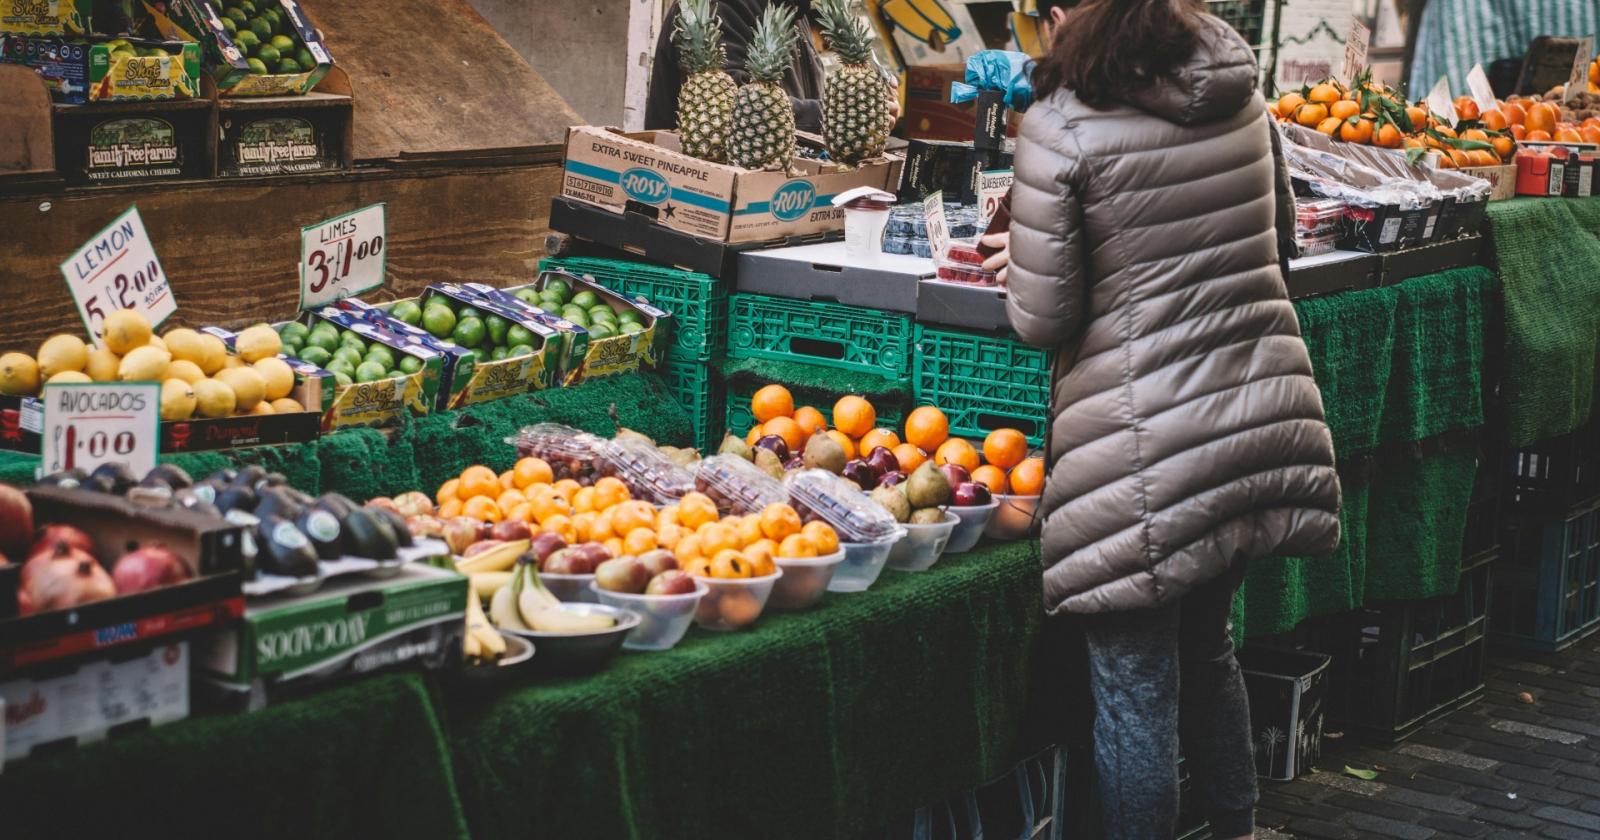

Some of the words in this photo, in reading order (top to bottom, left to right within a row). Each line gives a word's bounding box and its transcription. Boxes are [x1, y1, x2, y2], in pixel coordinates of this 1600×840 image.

[111, 169, 148, 178] CALIFORNIA
[149, 167, 181, 176] CHERRIES
[592, 142, 621, 159] EXTRA
[623, 150, 656, 167] SWEET
[657, 160, 709, 182] PINEAPPLE
[627, 174, 664, 197] ROSY
[981, 177, 1014, 190] BLUEBERRIE
[776, 190, 811, 213] ROSY
[810, 210, 831, 222] EXTRA
[320, 217, 357, 243] LIMES
[75, 221, 134, 279] LEMON
[59, 390, 146, 413] AVOCADOS
